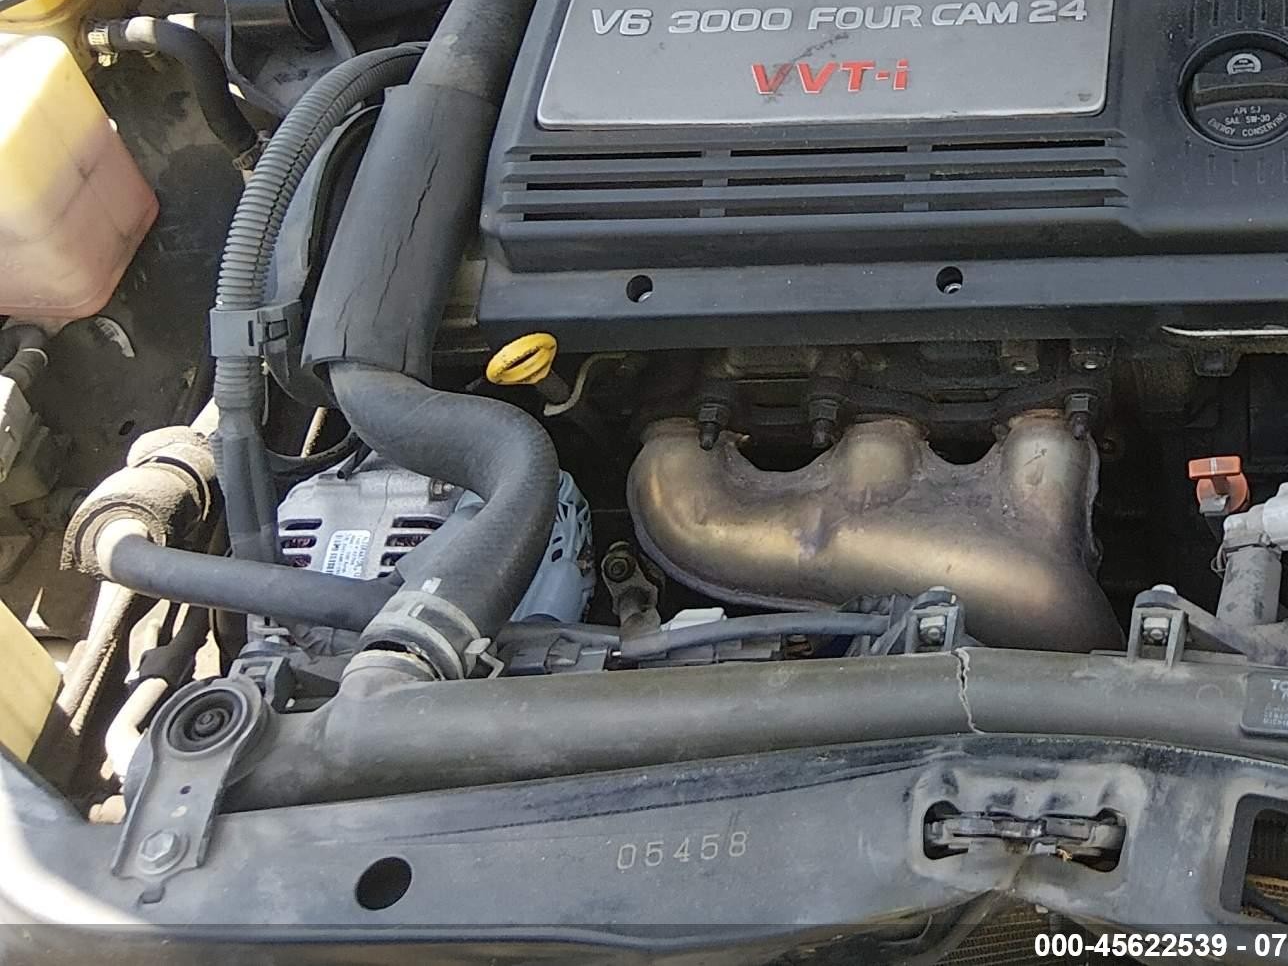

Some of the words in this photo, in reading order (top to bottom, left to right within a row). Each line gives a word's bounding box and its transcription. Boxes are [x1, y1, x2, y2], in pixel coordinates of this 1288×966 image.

[591, 8, 654, 37] V6
[667, 7, 794, 34] 3000
[807, 4, 923, 31] FOUR
[931, 0, 1019, 26] CAM
[751, 59, 910, 95] VVT-i
[1207, 117, 1237, 136] ENERGY
[1241, 112, 1288, 137] CONSERVING
[1245, 113, 1271, 124] 5W-30
[617, 831, 747, 870] 05458
